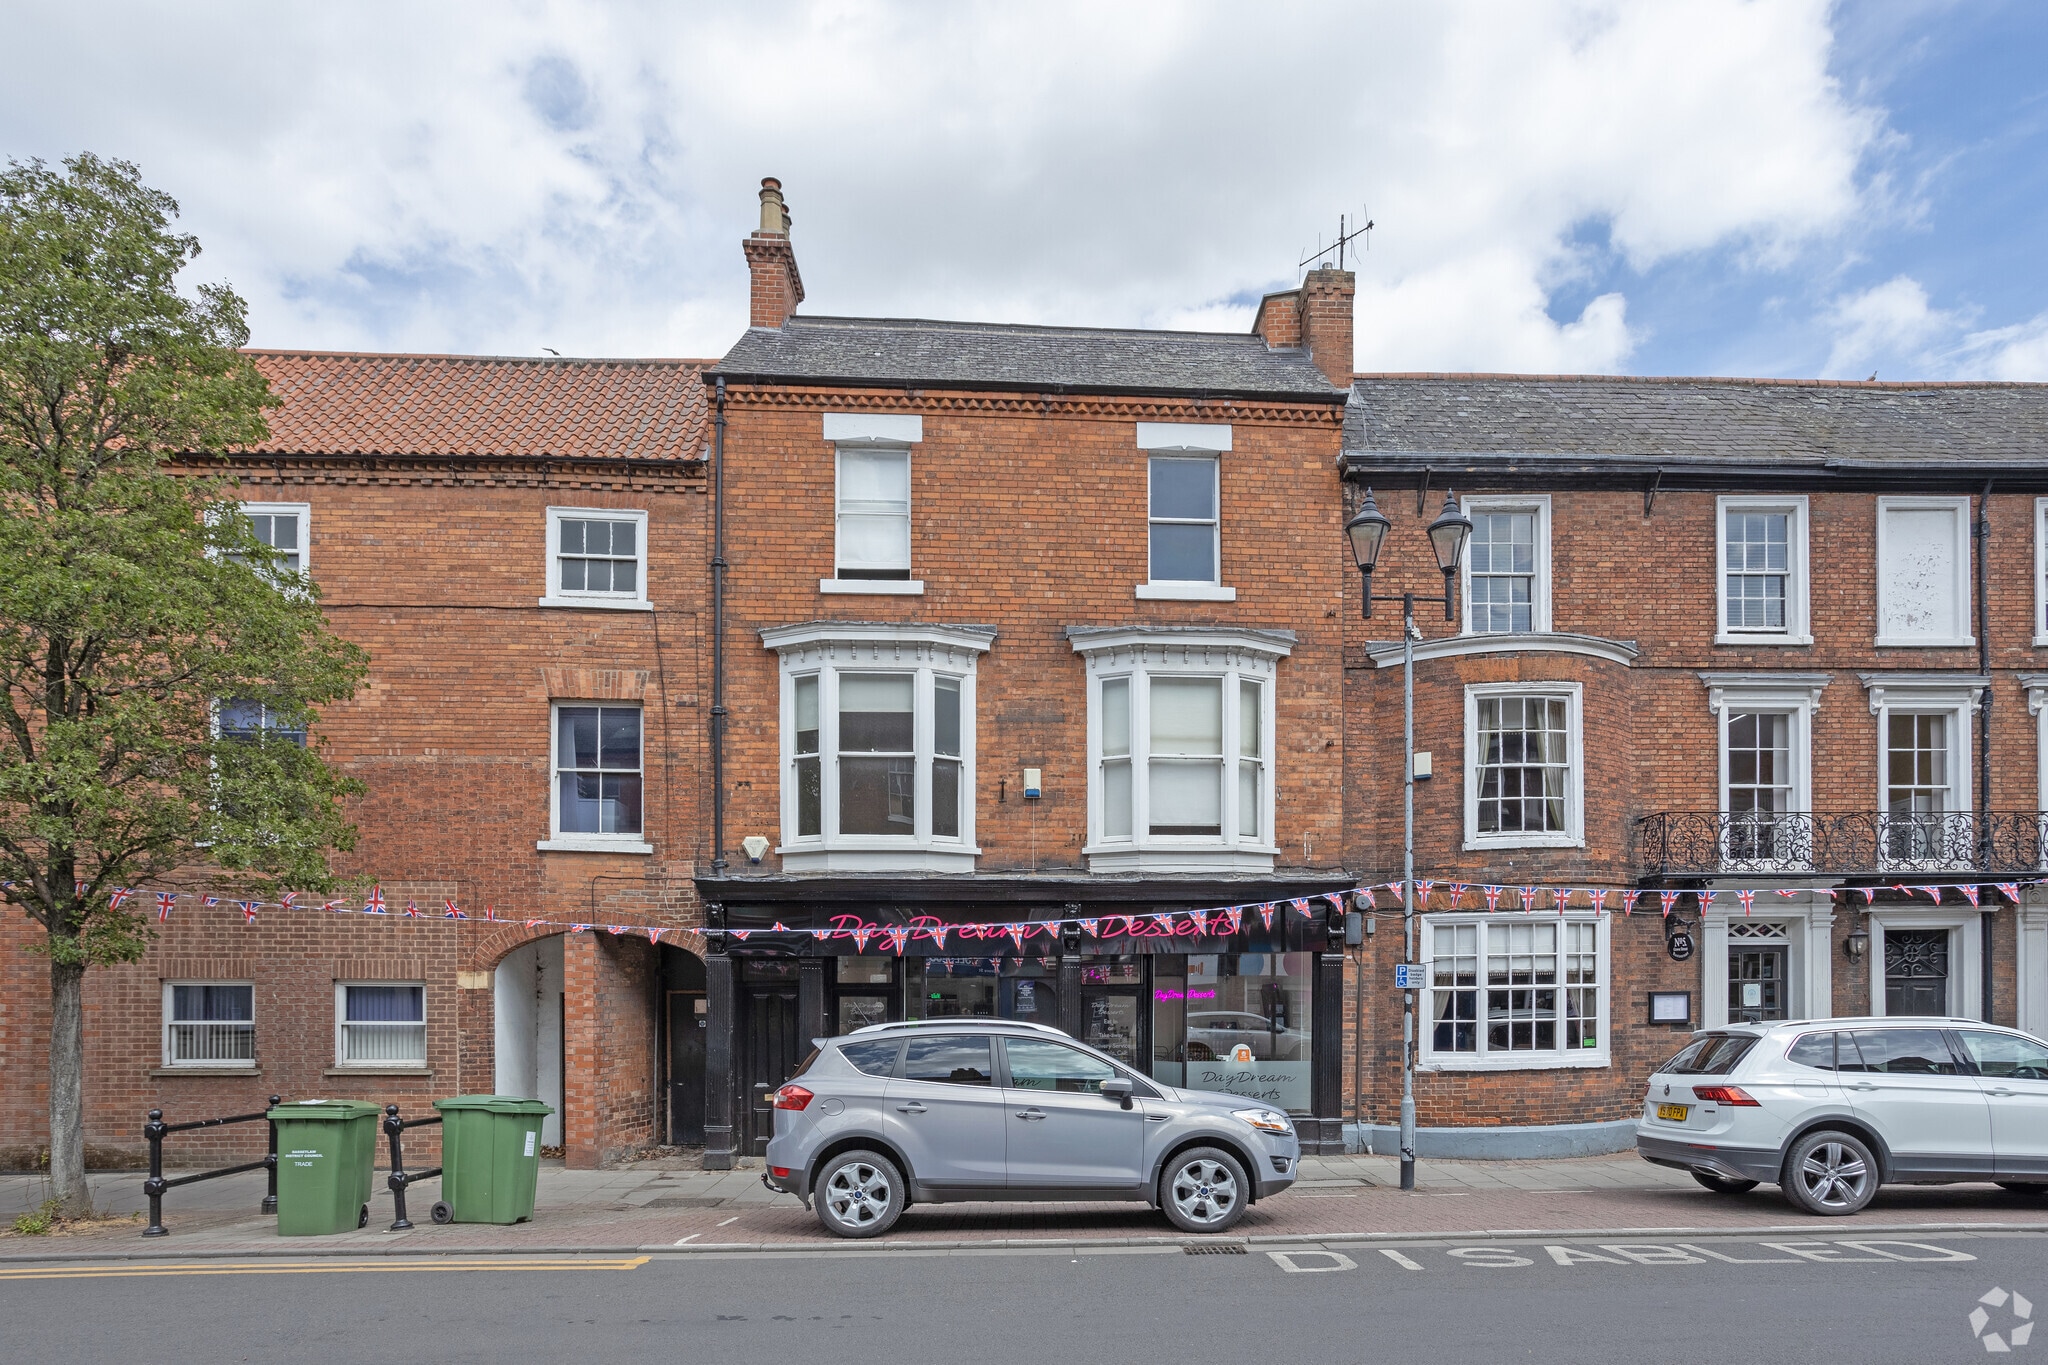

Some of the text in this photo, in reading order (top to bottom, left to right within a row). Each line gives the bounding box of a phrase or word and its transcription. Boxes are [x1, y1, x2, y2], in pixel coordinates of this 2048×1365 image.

[1399, 966, 1406, 975] P
[1201, 1071, 1297, 1087] DayDream
[1266, 1241, 1978, 1273] DISABLED
